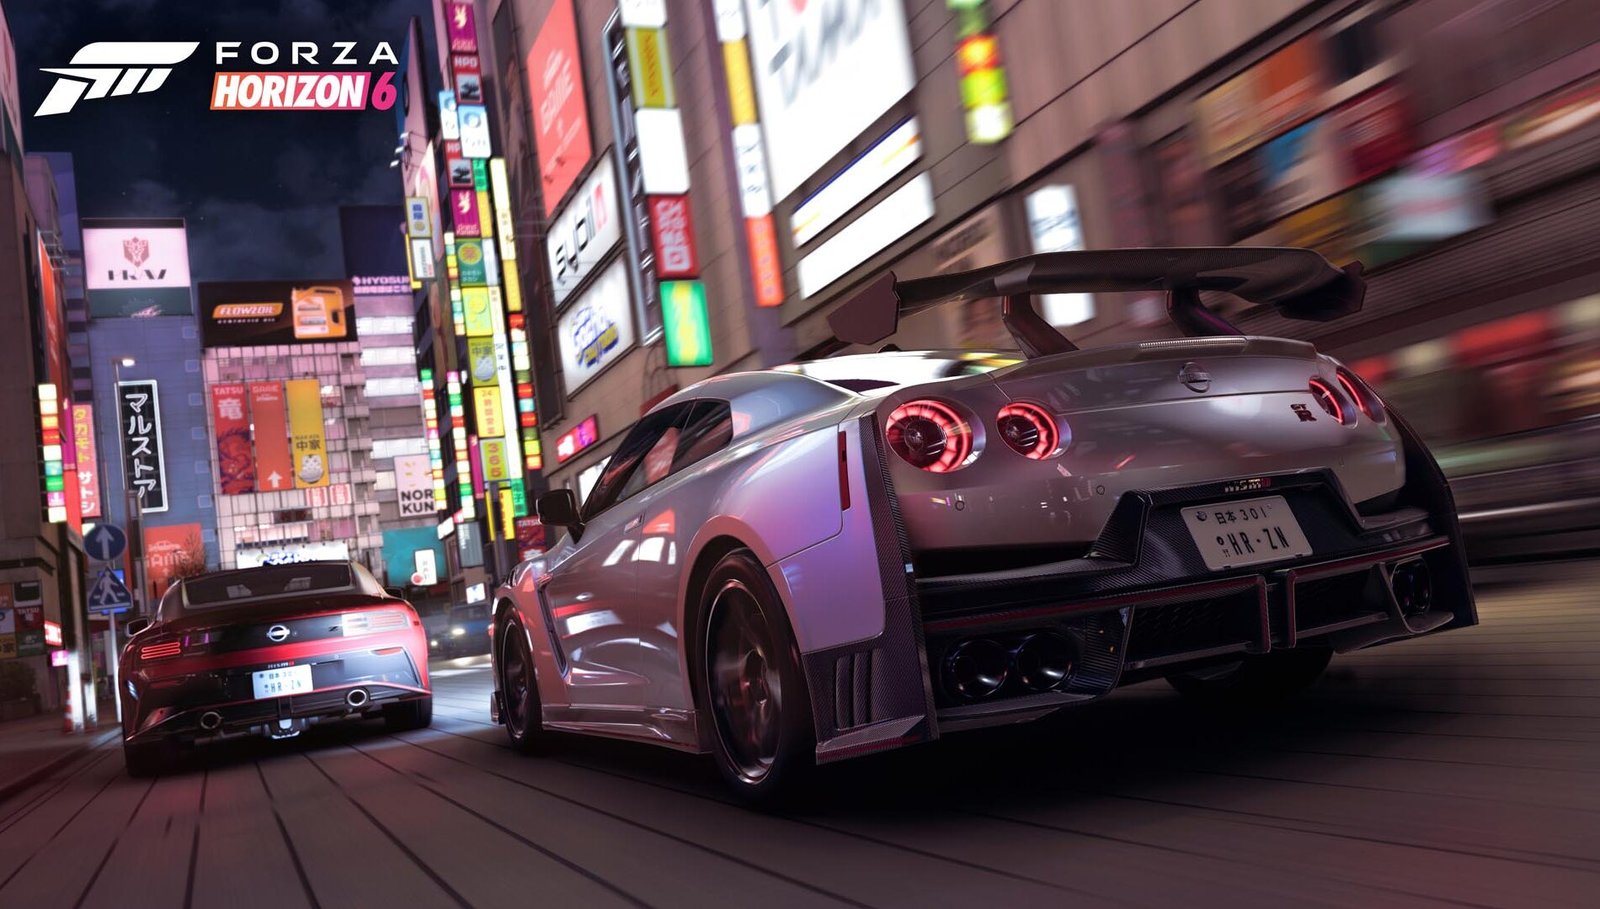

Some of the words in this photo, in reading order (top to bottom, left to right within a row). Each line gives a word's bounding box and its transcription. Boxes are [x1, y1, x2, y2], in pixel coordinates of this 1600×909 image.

[214, 386, 244, 396] TATSU
[125, 393, 156, 498] マルストア
[401, 489, 433, 501] NOR
[402, 502, 435, 514] KUN
[1214, 511, 1237, 524] 日本
